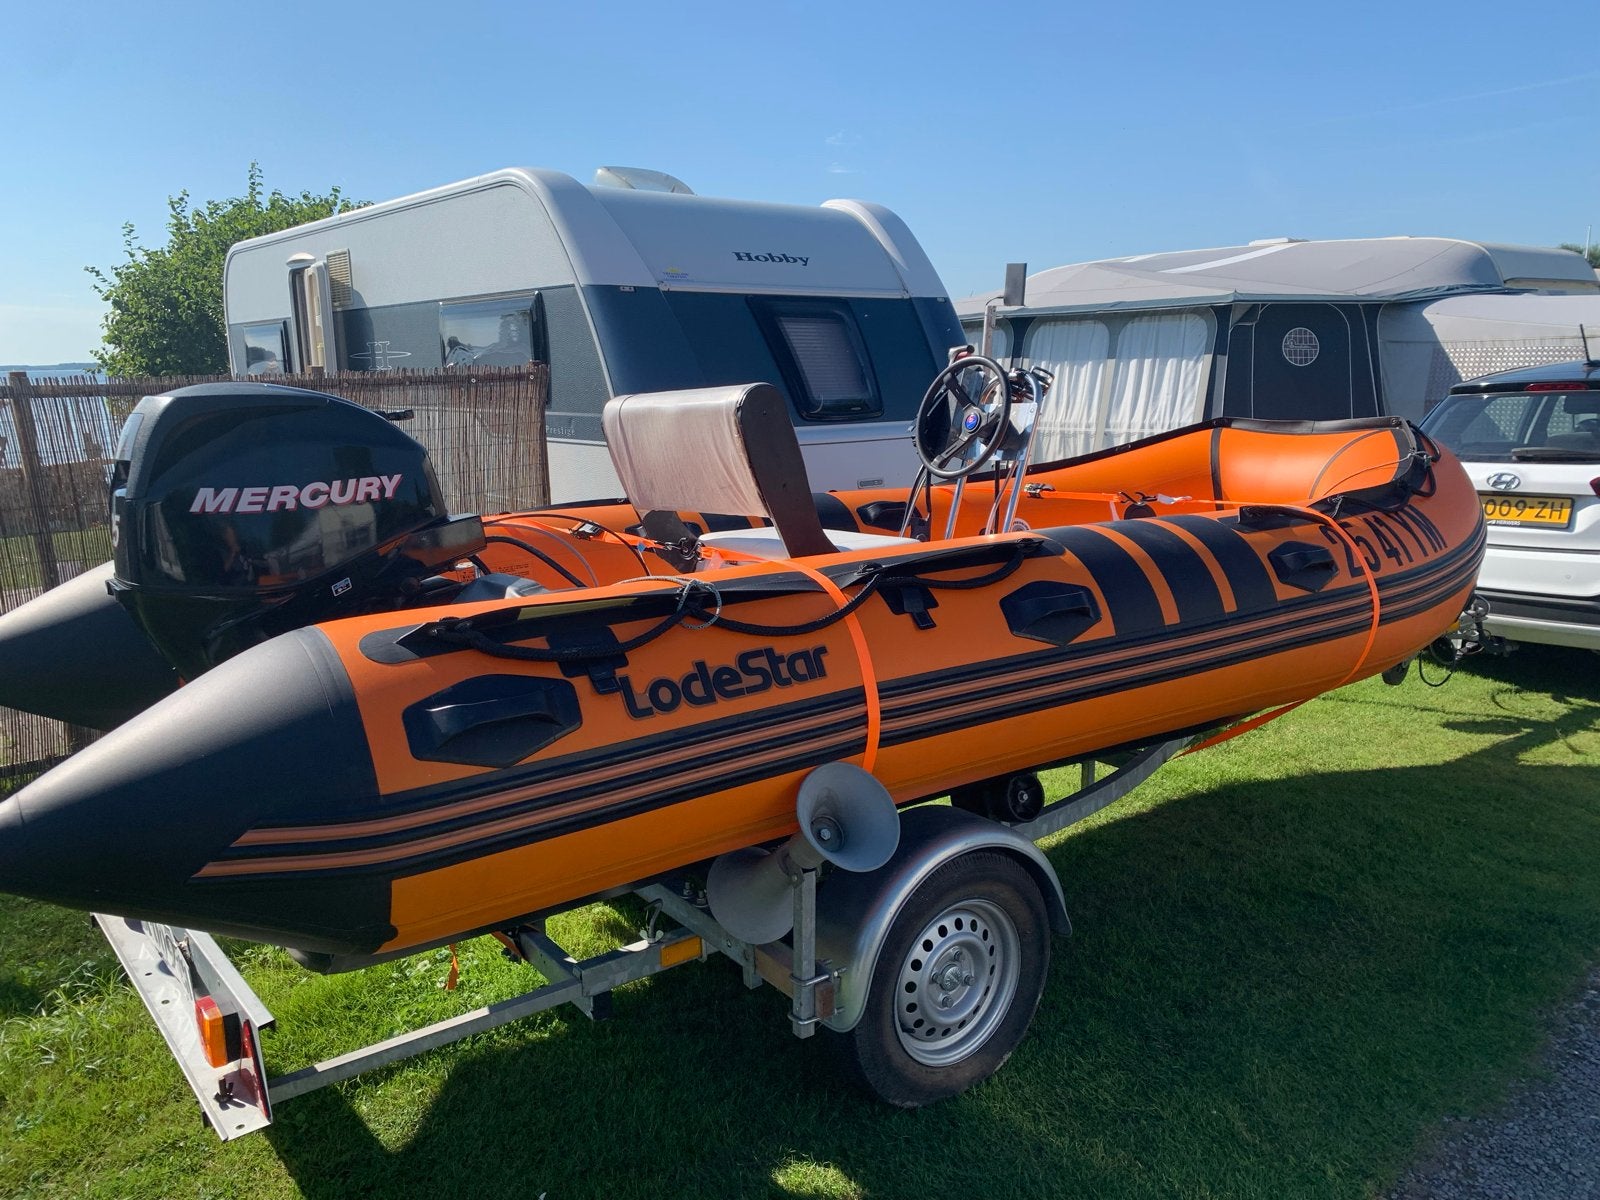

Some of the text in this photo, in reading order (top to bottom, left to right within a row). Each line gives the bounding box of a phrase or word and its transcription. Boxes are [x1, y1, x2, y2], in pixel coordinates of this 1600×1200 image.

[732, 251, 810, 266] Hobby
[189, 474, 402, 515] MERCURY
[618, 645, 829, 719] LodeStar
